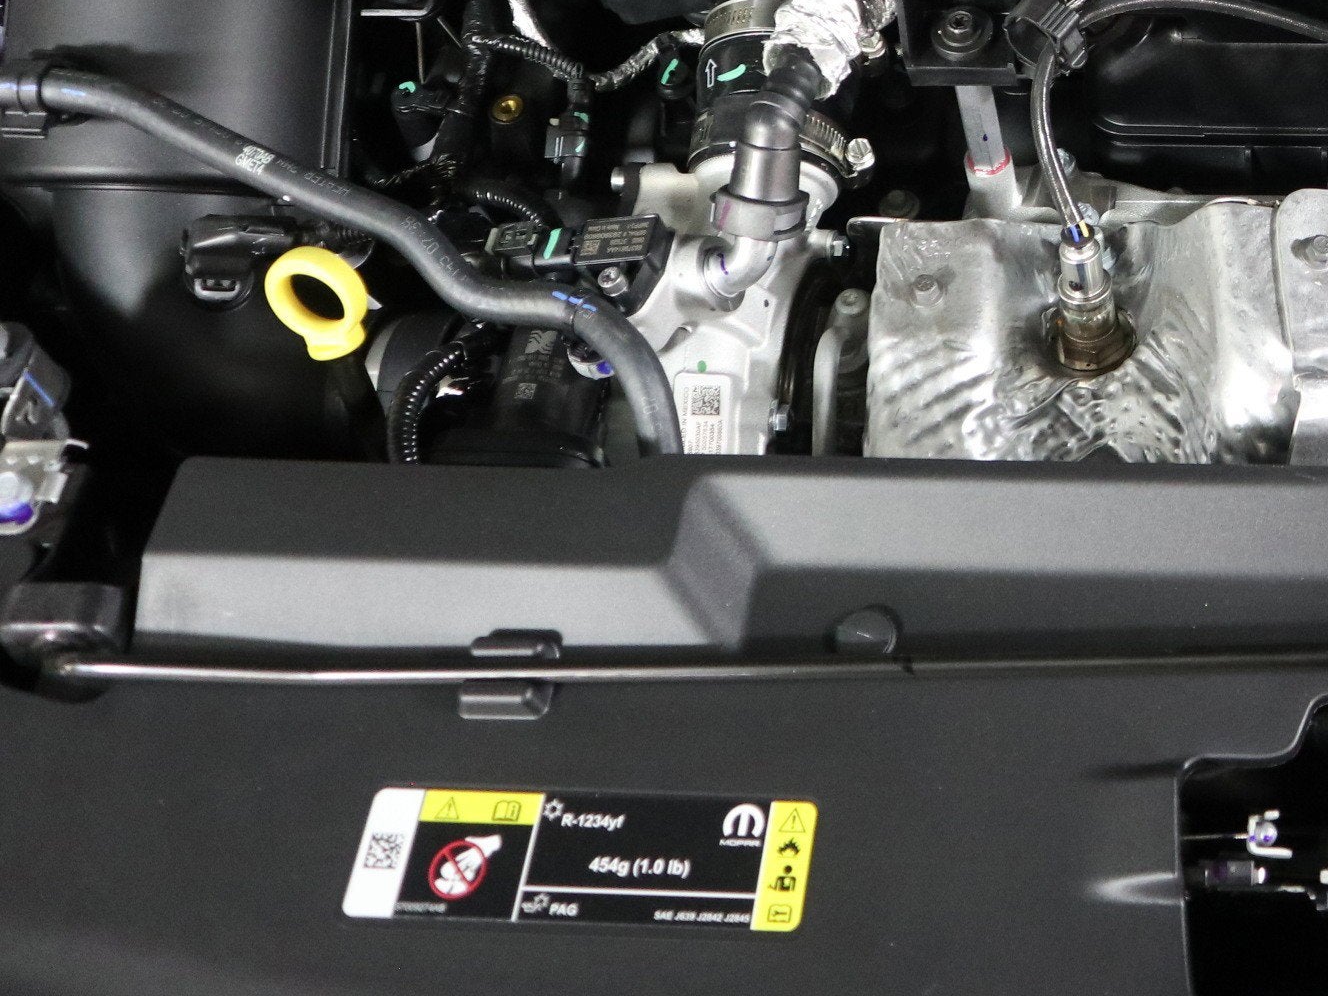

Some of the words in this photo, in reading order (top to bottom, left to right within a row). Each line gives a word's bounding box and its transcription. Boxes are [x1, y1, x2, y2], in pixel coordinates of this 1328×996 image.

[561, 813, 627, 832] R-1234yf
[588, 855, 632, 877] 454g
[632, 857, 666, 878] (1.0
[666, 858, 692, 880] lb)
[549, 902, 579, 917] PAG
